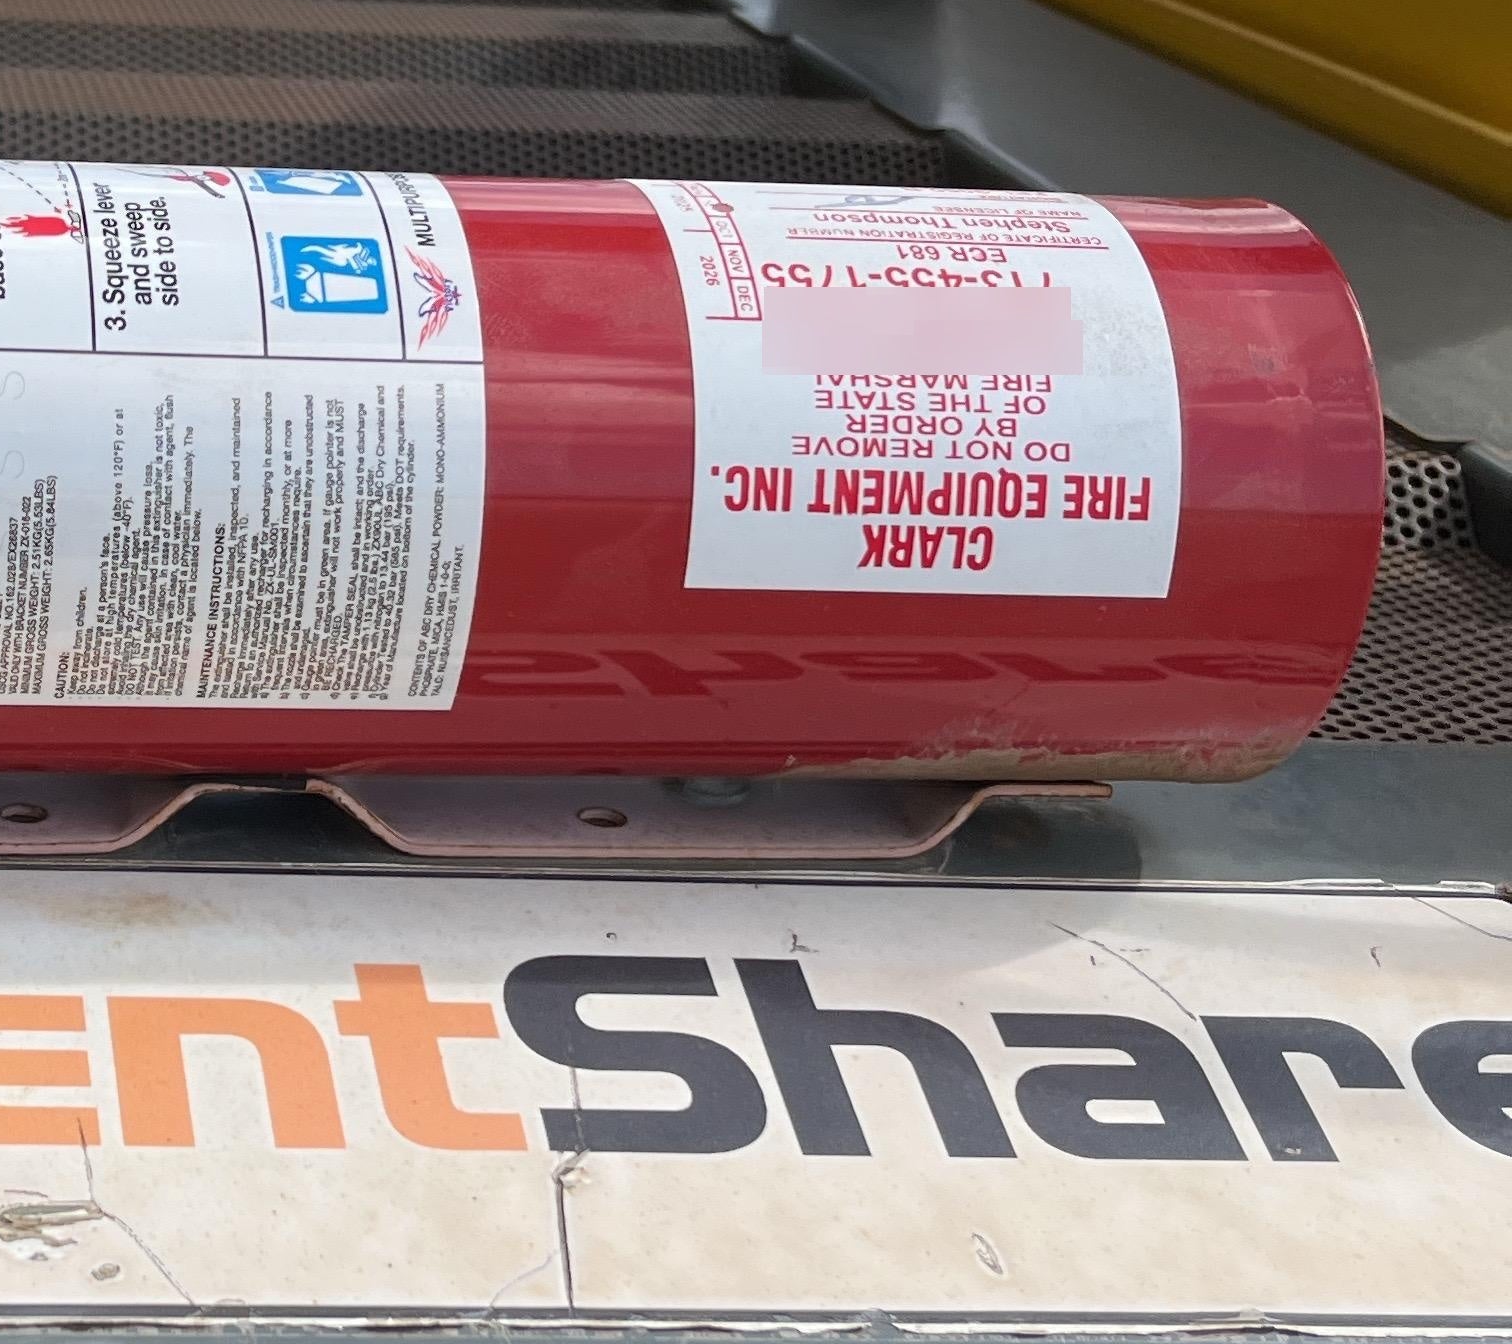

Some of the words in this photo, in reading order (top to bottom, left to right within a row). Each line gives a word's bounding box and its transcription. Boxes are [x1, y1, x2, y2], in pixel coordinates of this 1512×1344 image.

[92, 183, 116, 213] lever
[148, 196, 171, 231] side.
[813, 212, 954, 229] Thompson
[962, 211, 1071, 233] Stephen
[123, 203, 149, 258] sweep
[860, 228, 974, 241] REGISTRATION
[980, 233, 999, 243] OF
[1005, 233, 1102, 245] CERTIFICATE
[152, 237, 174, 255] to
[896, 245, 940, 261] 681
[947, 246, 1007, 263] ECR
[100, 219, 129, 304] Squeeze
[699, 255, 720, 286] 2026
[727, 249, 744, 273] NOV
[127, 264, 152, 306] and
[154, 261, 179, 306] side
[736, 285, 753, 312] DEC
[103, 310, 127, 331] 3.
[814, 390, 916, 412] STATE
[928, 393, 992, 413] THE
[1003, 395, 1046, 414] OF
[846, 414, 963, 435] ORDER
[977, 417, 1017, 436] BY
[791, 436, 934, 458] REMOVE
[944, 439, 1012, 461] NOT
[1024, 441, 1071, 463] DO
[711, 465, 793, 513] INC.
[807, 467, 1048, 519] EQUIPMENT
[1063, 474, 1152, 521] FIRE
[856, 523, 994, 571] CLARK
[196, 624, 217, 698] MAINTENANCE
[208, 523, 226, 620] INSTRUCTIONS:
[54, 652, 69, 699] CAUTION:
